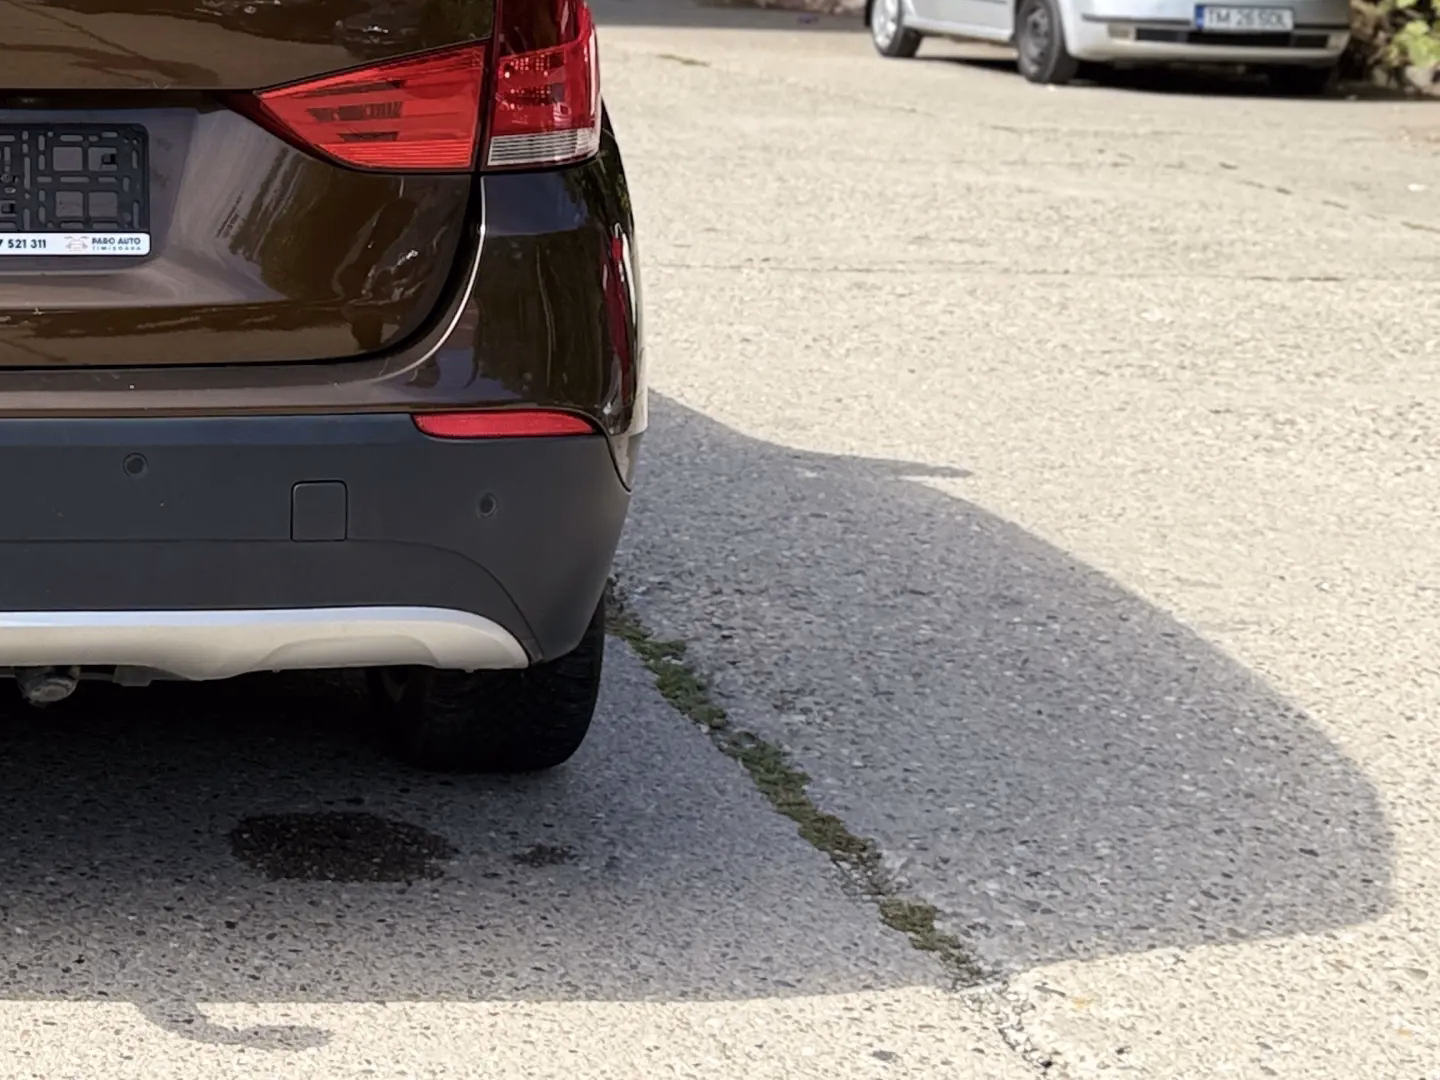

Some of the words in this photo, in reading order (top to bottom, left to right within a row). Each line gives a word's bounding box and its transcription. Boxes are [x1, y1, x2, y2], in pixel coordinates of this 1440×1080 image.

[7, 238, 28, 249] 521
[30, 238, 47, 249] 311
[117, 236, 142, 245] AUTO
